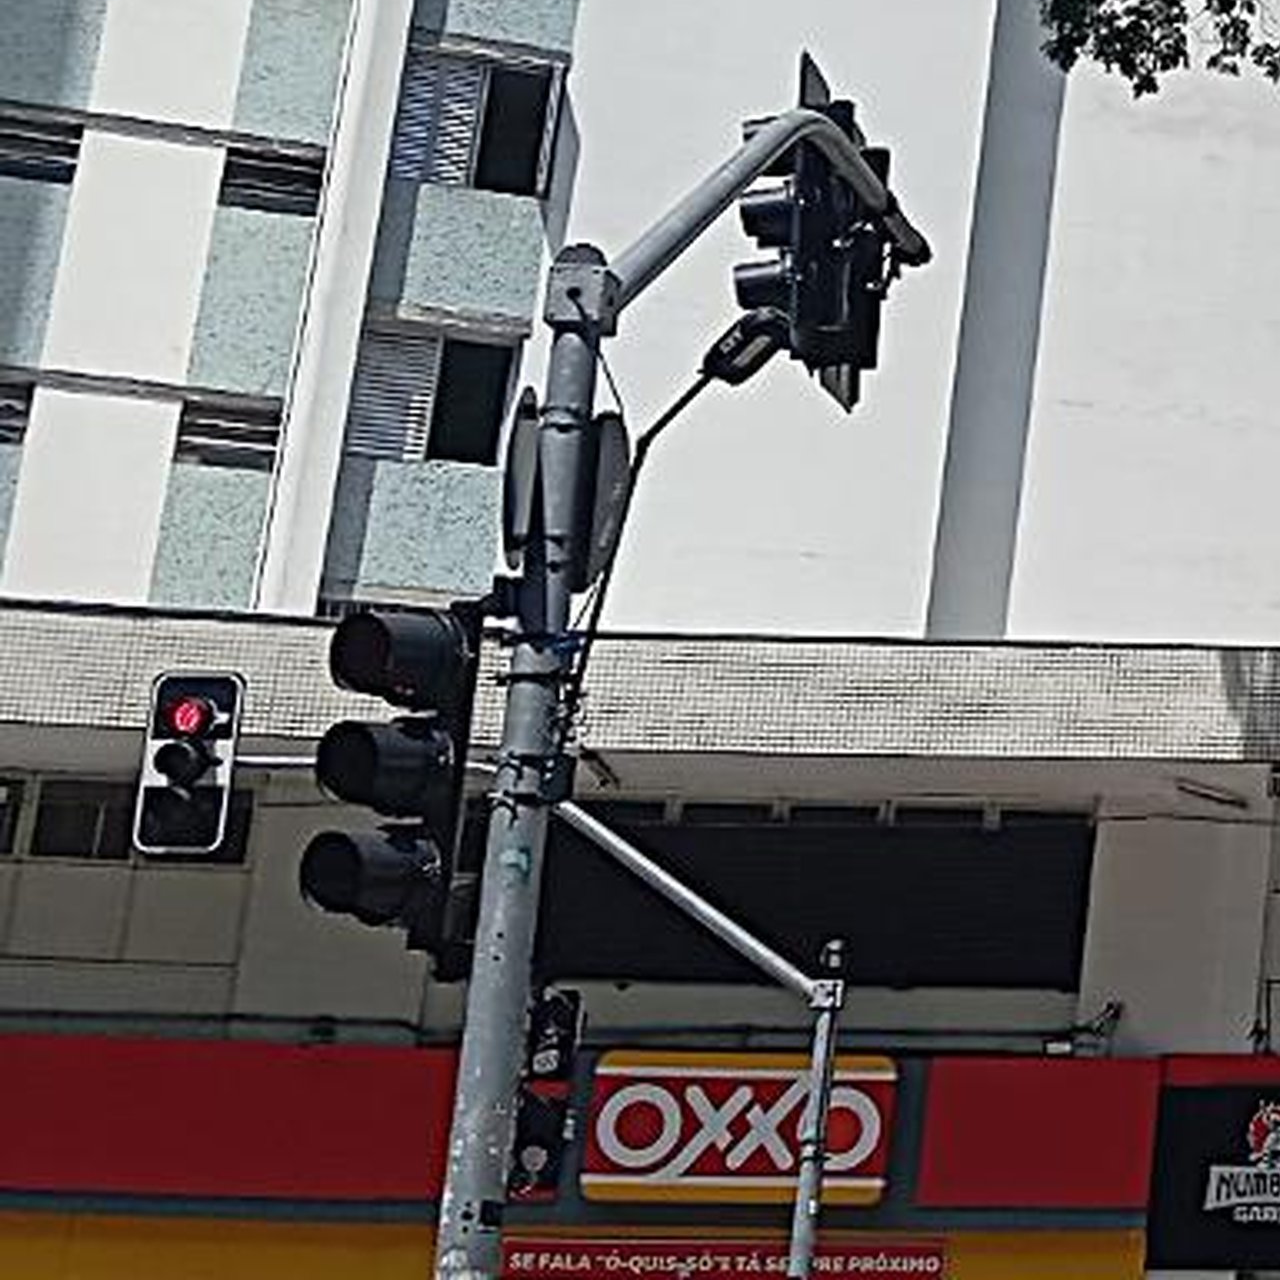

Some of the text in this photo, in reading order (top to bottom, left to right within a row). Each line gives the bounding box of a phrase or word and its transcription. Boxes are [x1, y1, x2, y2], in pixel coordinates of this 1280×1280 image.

[597, 1077, 881, 1179] OXXO
[509, 1252, 535, 1271] SE
[538, 1252, 592, 1271] FALA
[735, 1251, 761, 1272] TÁ
[765, 1255, 844, 1272] SERE
[848, 1252, 940, 1273] PRÓXIMO
